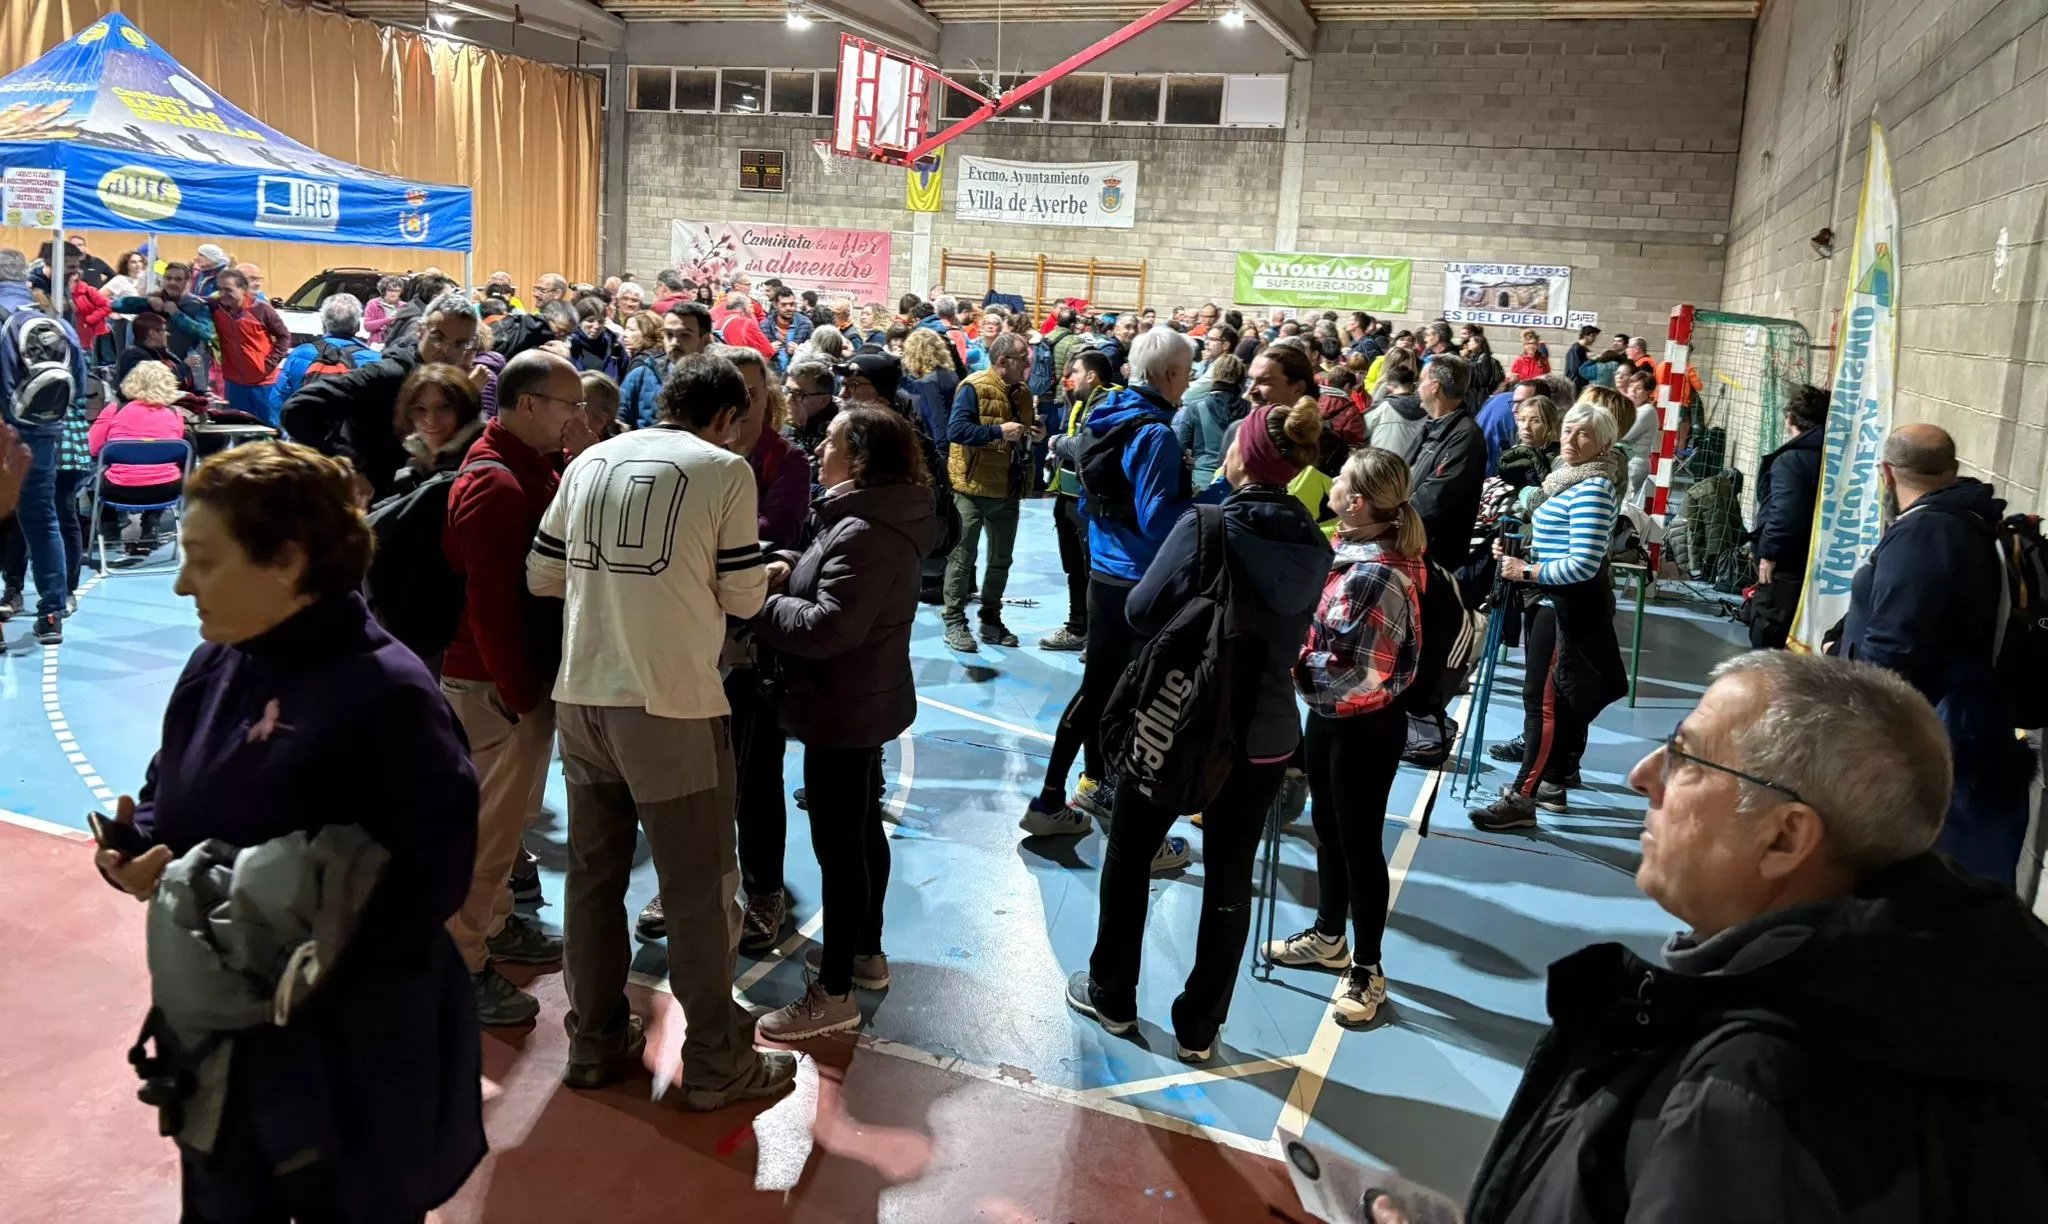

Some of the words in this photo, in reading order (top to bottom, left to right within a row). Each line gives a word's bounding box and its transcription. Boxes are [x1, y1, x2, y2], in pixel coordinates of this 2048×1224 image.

[968, 166, 1008, 182] Excmo.
[1010, 170, 1090, 186] Ayuntamiento
[967, 188, 1002, 211] Villa
[1008, 192, 1027, 212] de
[1030, 194, 1088, 218] Ayerbe
[840, 232, 882, 258] flor
[745, 259, 763, 272] del
[765, 251, 875, 279] almendro
[1506, 265, 1521, 276] DE
[1266, 278, 1373, 293] SUPERMERCADOS
[1443, 310, 1462, 321] ES
[1467, 312, 1496, 323] DEL
[1500, 313, 1563, 326] PUEBLO
[568, 458, 688, 576] 10
